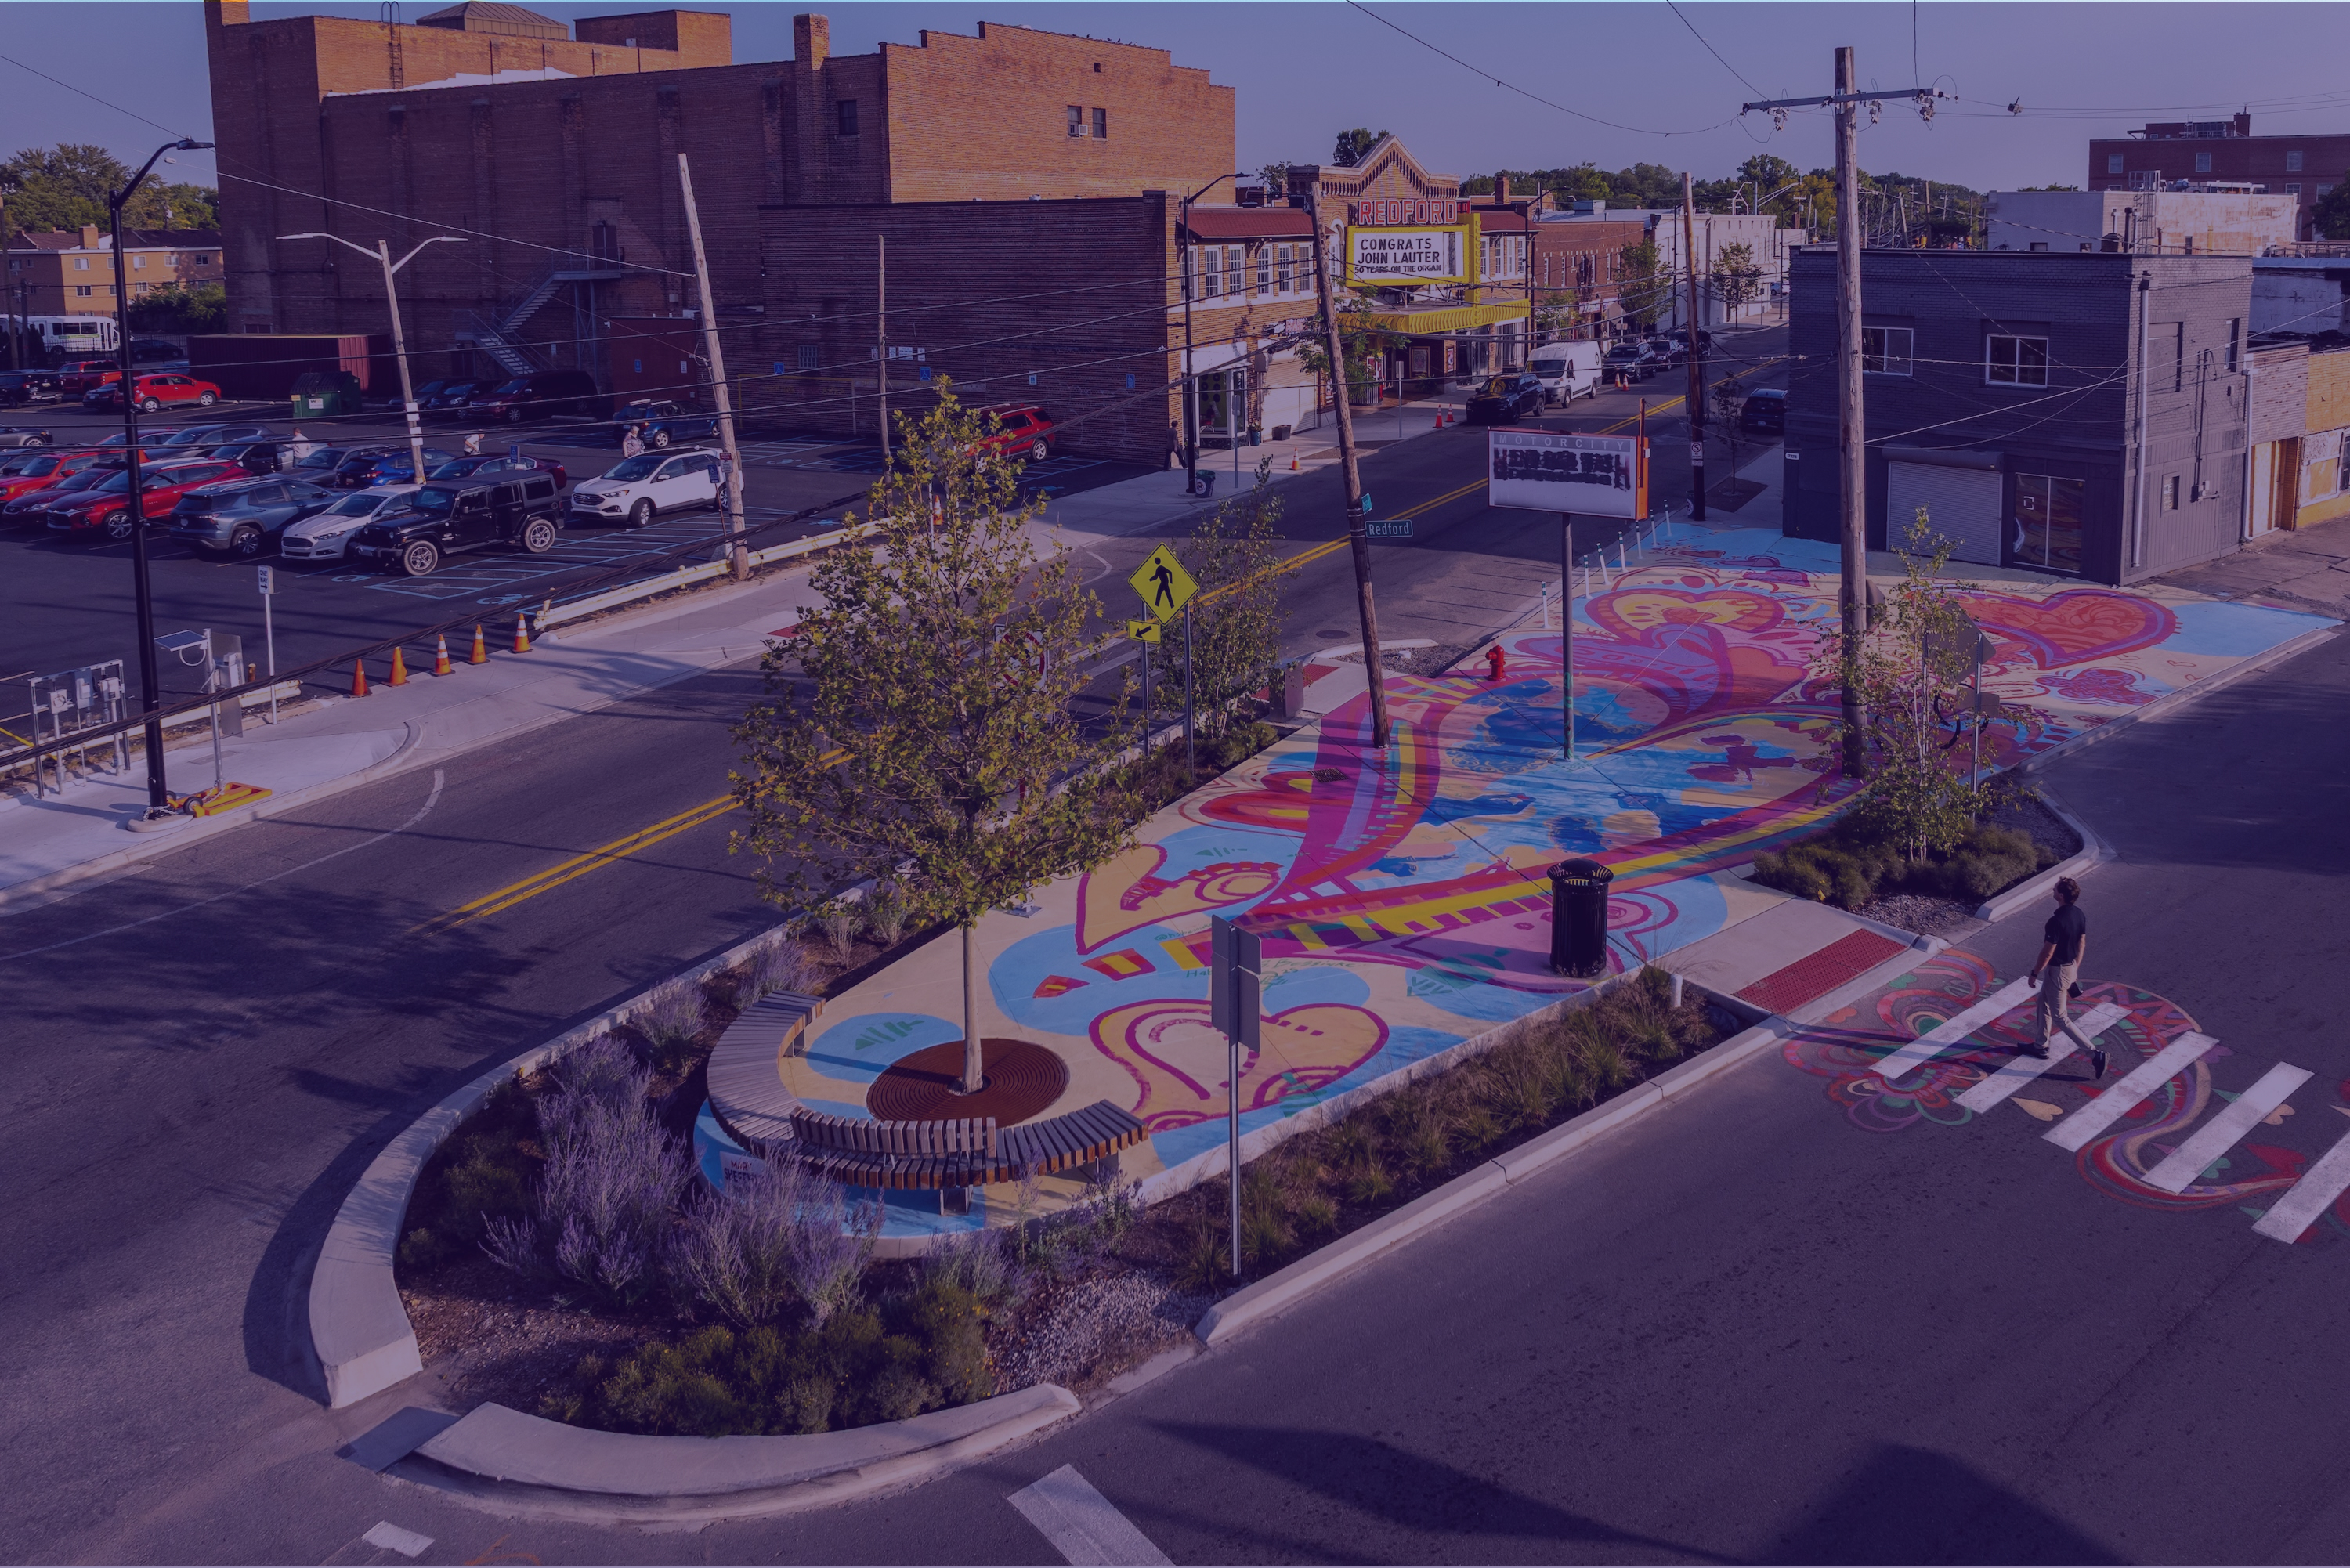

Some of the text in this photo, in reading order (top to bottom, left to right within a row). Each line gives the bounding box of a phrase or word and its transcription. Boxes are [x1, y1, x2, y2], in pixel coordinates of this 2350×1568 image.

[1358, 199, 1458, 225] REDFORD
[1360, 237, 1432, 250] CONGRATS
[1358, 251, 1440, 264] JOHN LAUTER
[1368, 522, 1410, 535] Redford
